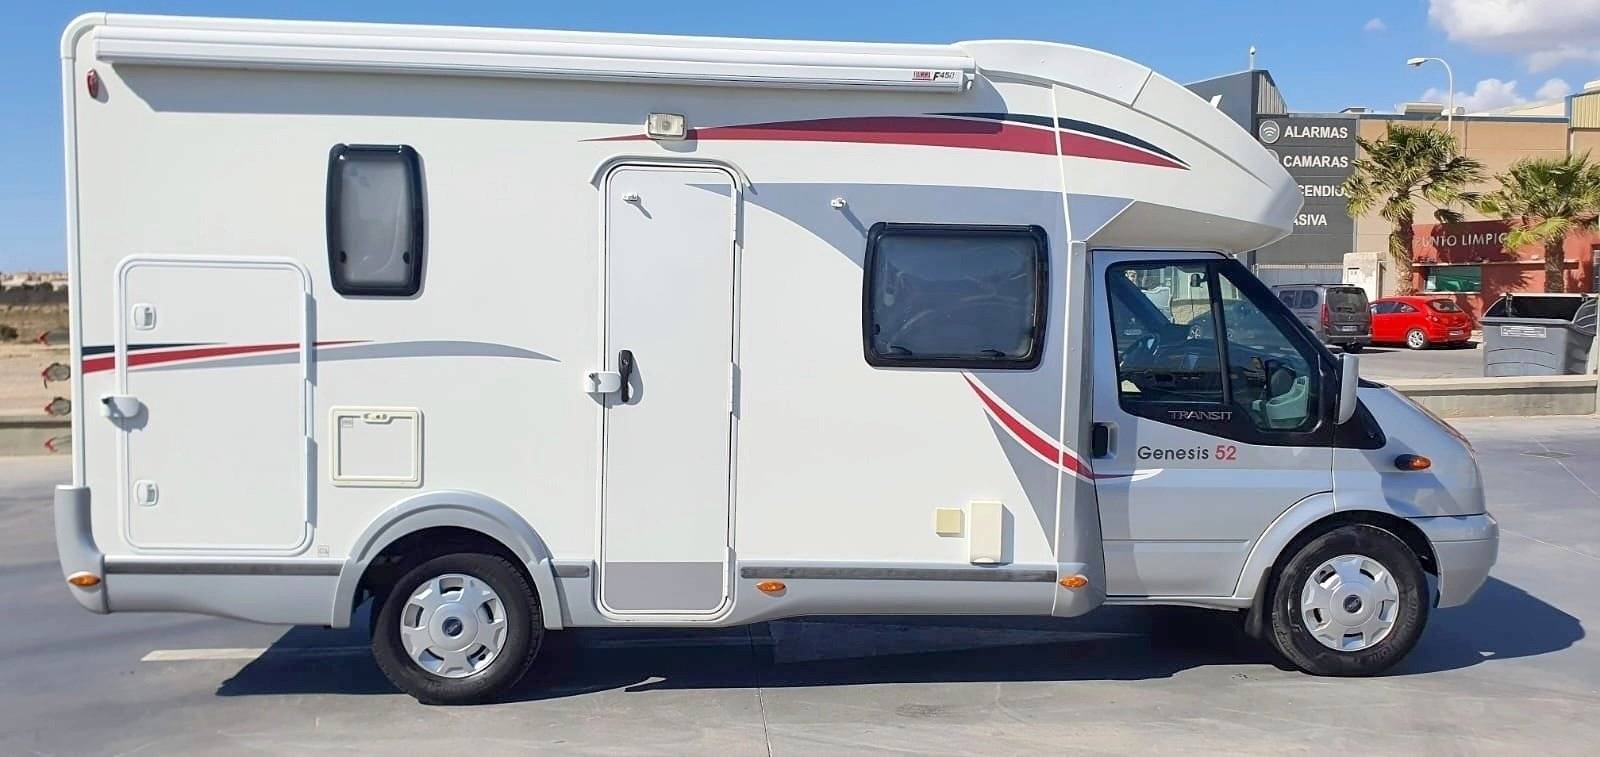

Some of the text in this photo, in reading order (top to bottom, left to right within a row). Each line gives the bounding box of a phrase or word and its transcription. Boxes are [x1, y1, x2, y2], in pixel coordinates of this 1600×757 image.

[1284, 126, 1348, 139] ALARMAS
[1283, 155, 1348, 168] CAMARAS
[1168, 410, 1232, 420] TRANSIT
[1137, 445, 1237, 460] Genesis 52
